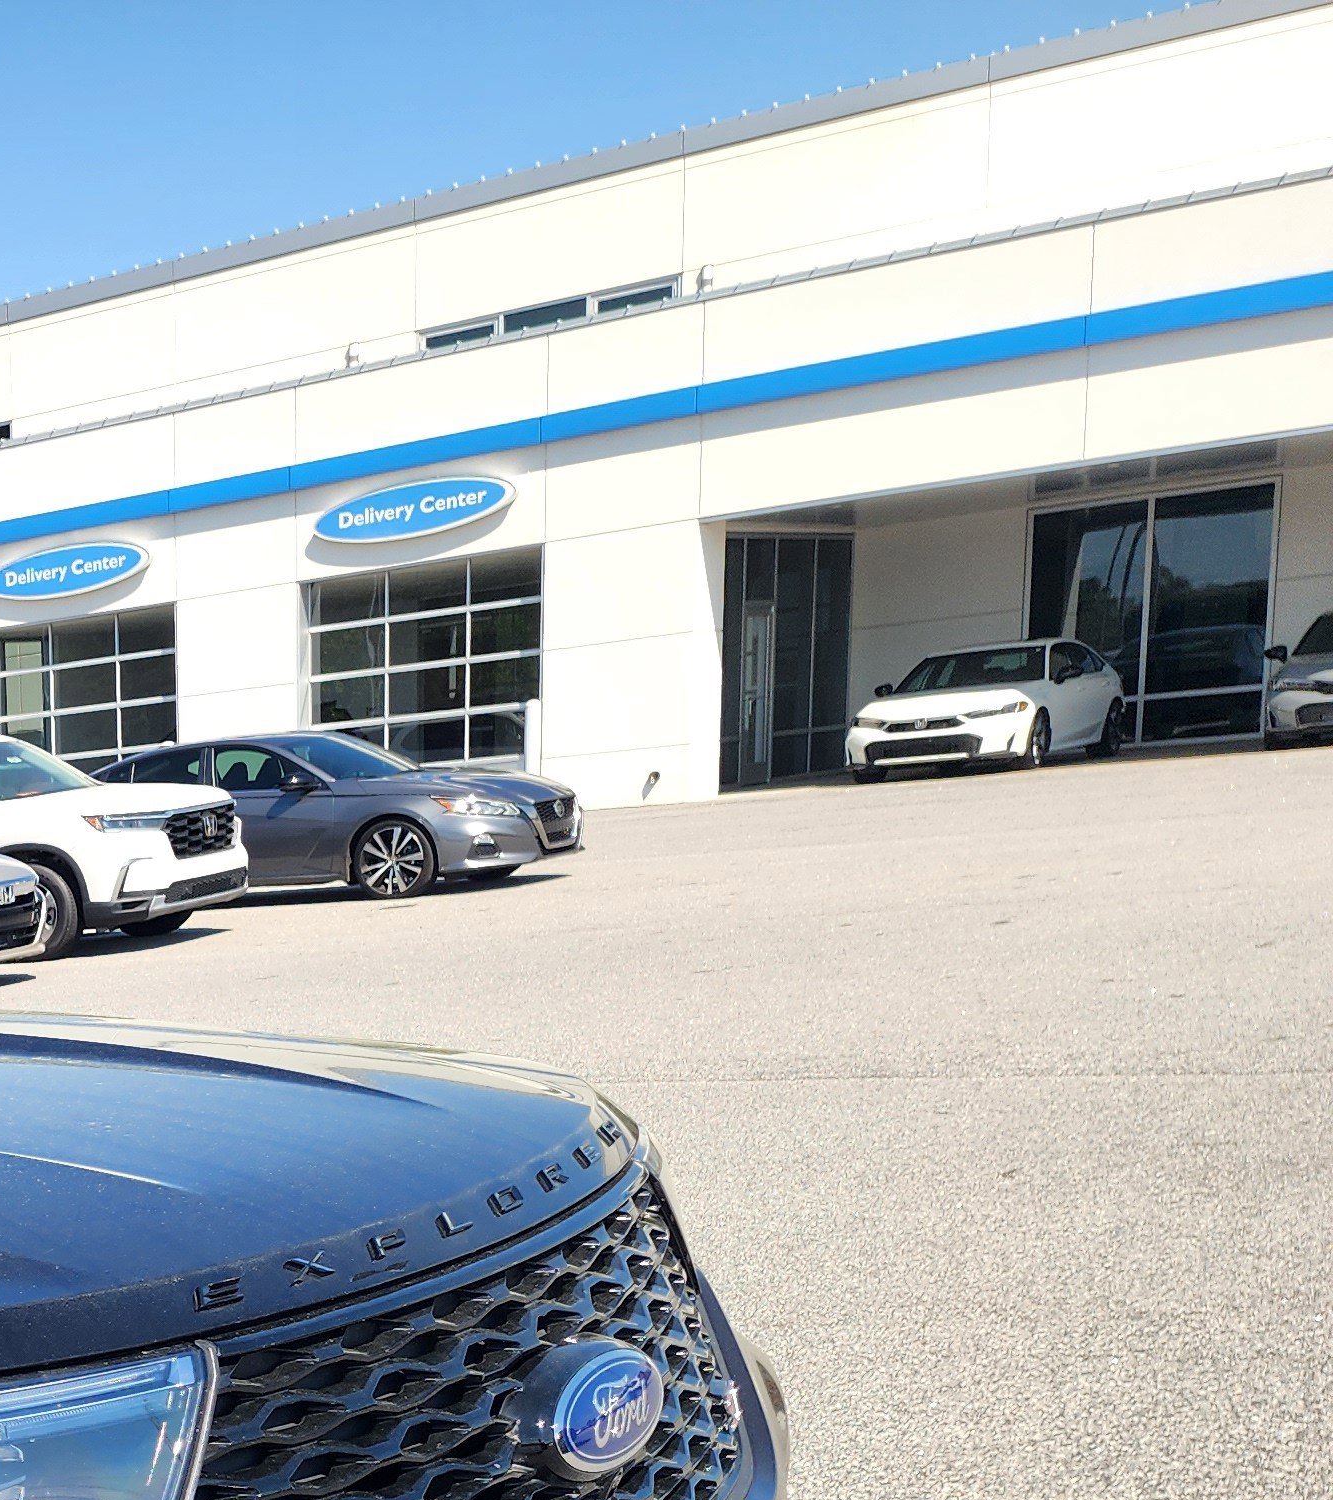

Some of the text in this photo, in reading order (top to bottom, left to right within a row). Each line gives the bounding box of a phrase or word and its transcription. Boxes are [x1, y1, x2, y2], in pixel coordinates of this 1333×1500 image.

[338, 488, 487, 530] Delivery Center
[4, 553, 126, 588] Delivery Center
[194, 1121, 621, 1313] EXPLORER
[593, 1374, 650, 1449] Ford
